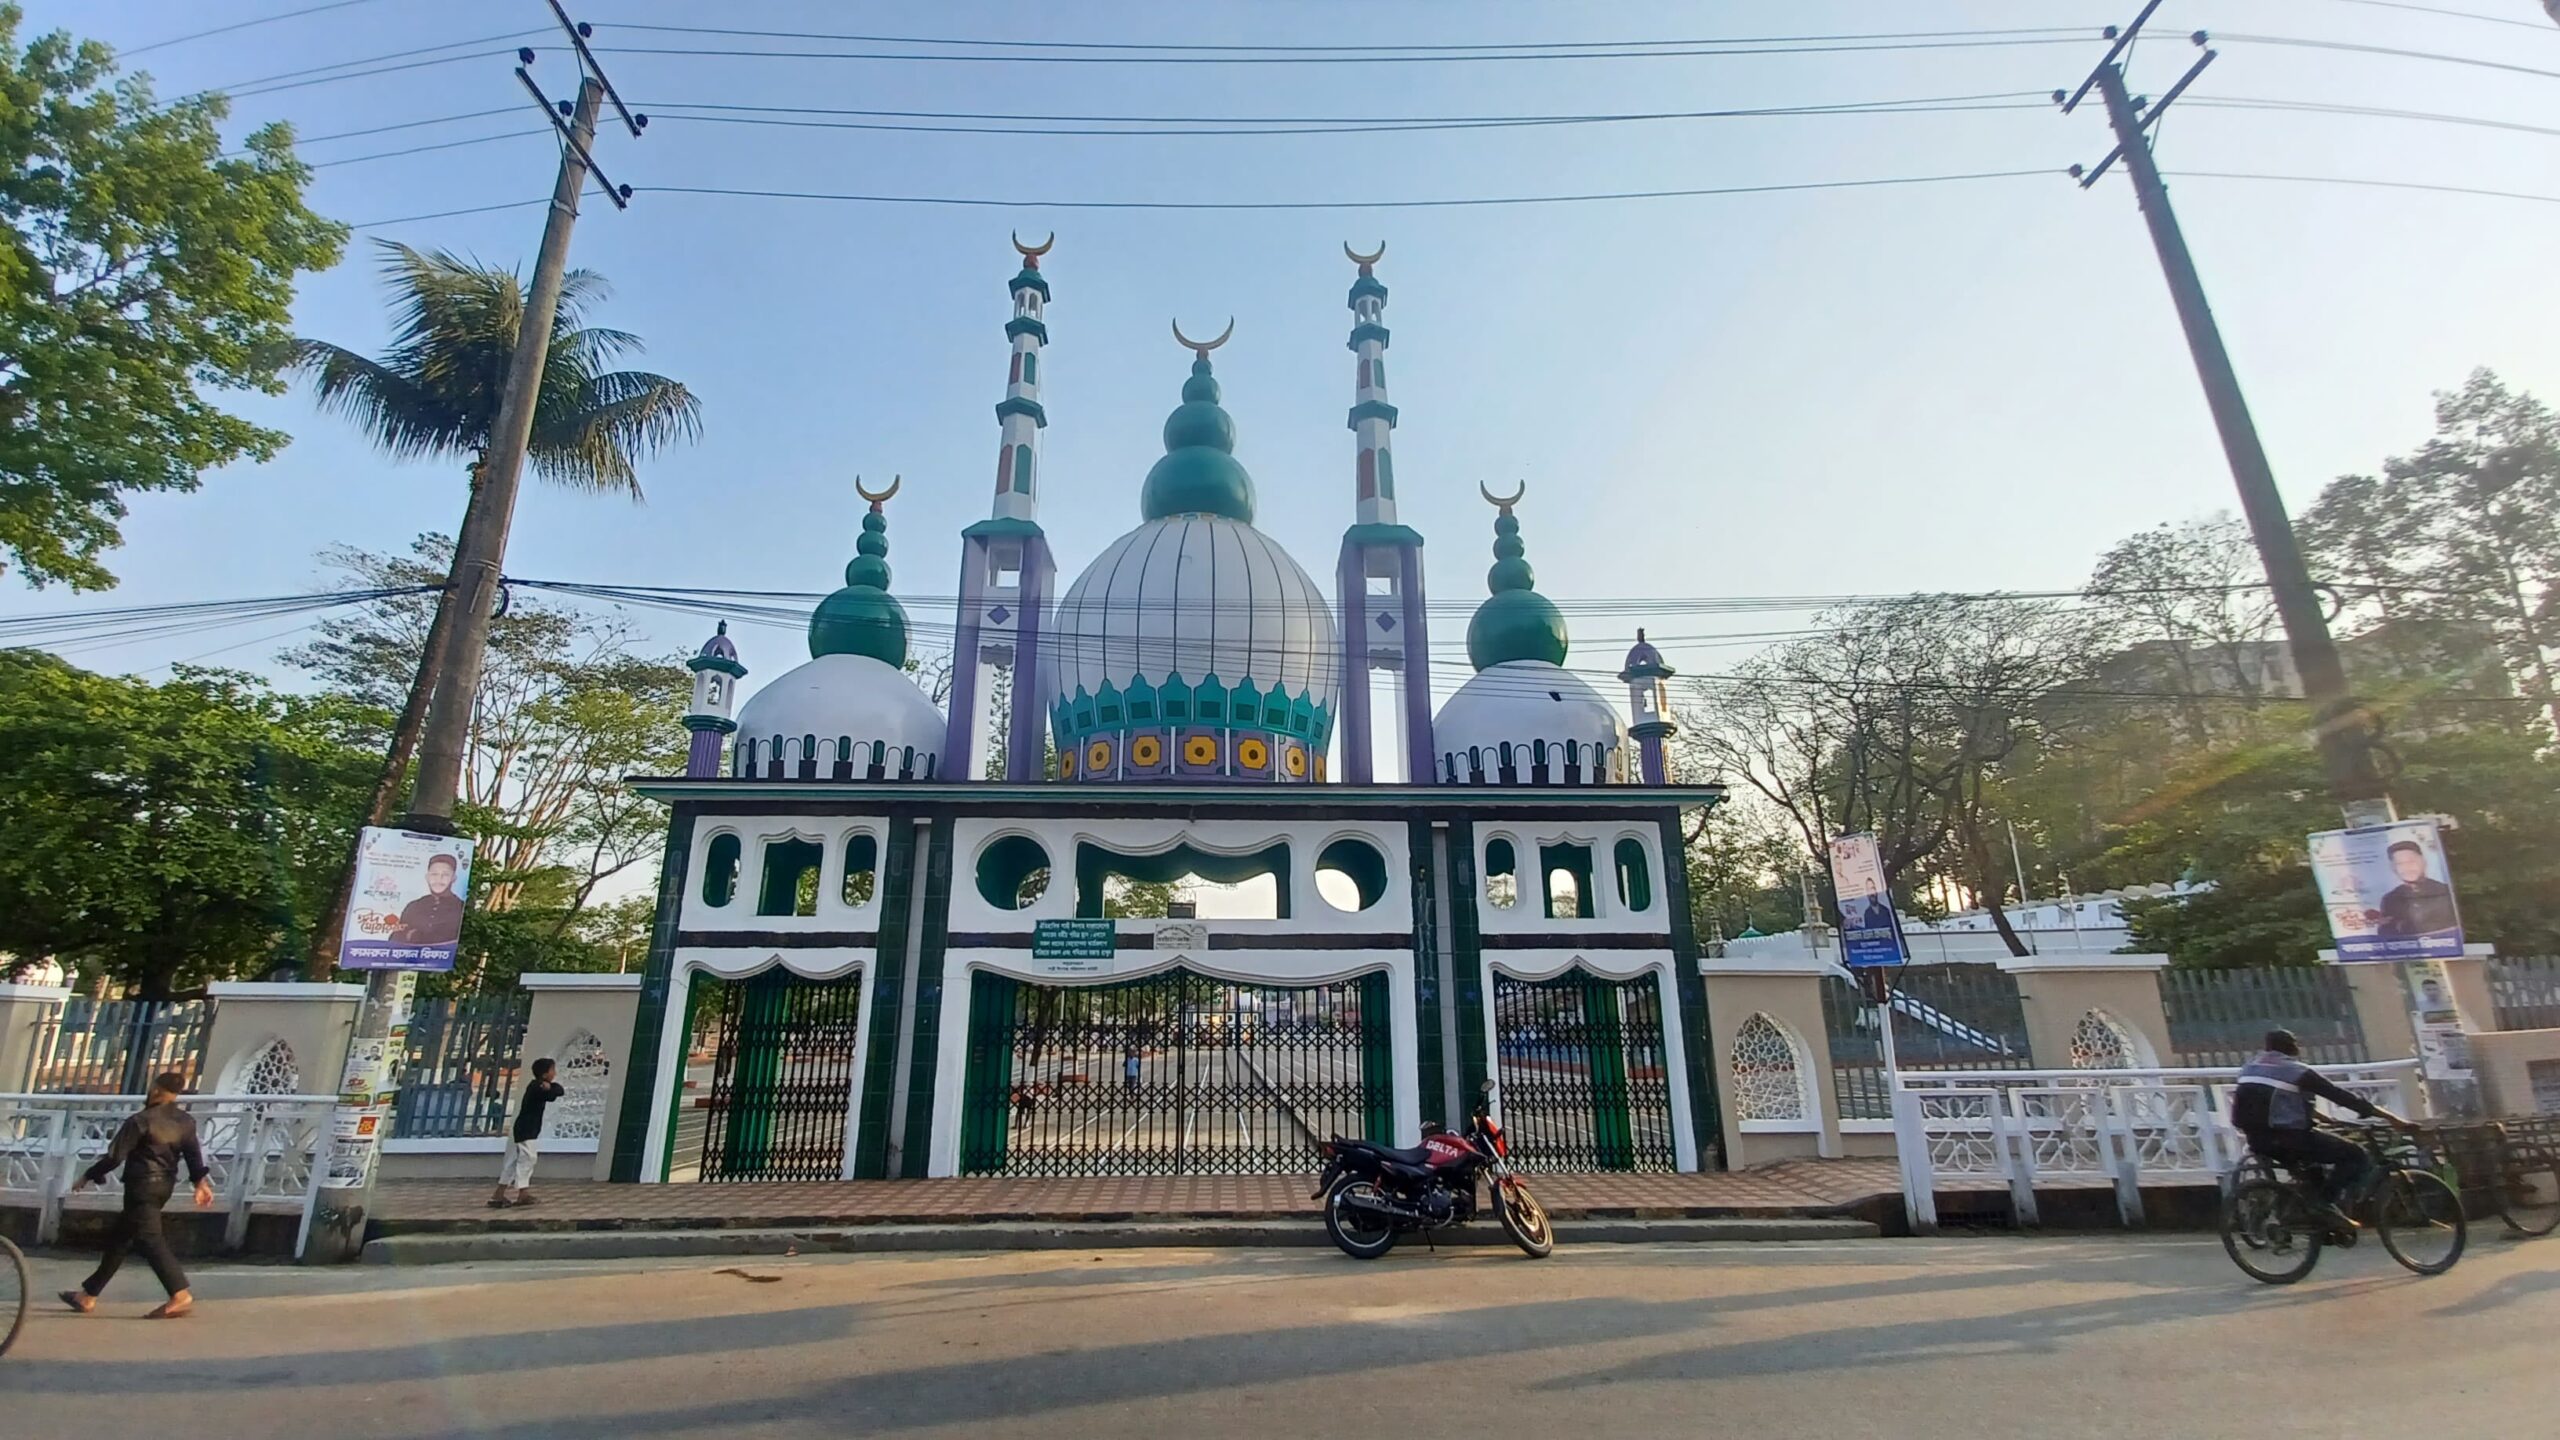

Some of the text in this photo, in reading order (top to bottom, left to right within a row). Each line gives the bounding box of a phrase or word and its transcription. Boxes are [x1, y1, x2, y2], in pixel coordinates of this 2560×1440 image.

[361, 921, 408, 935] মোবারক
[1061, 922, 1070, 930] শাহী
[349, 947, 451, 960] কামরুল হাসান রিফাত
[1426, 1141, 1458, 1157] DELTA
